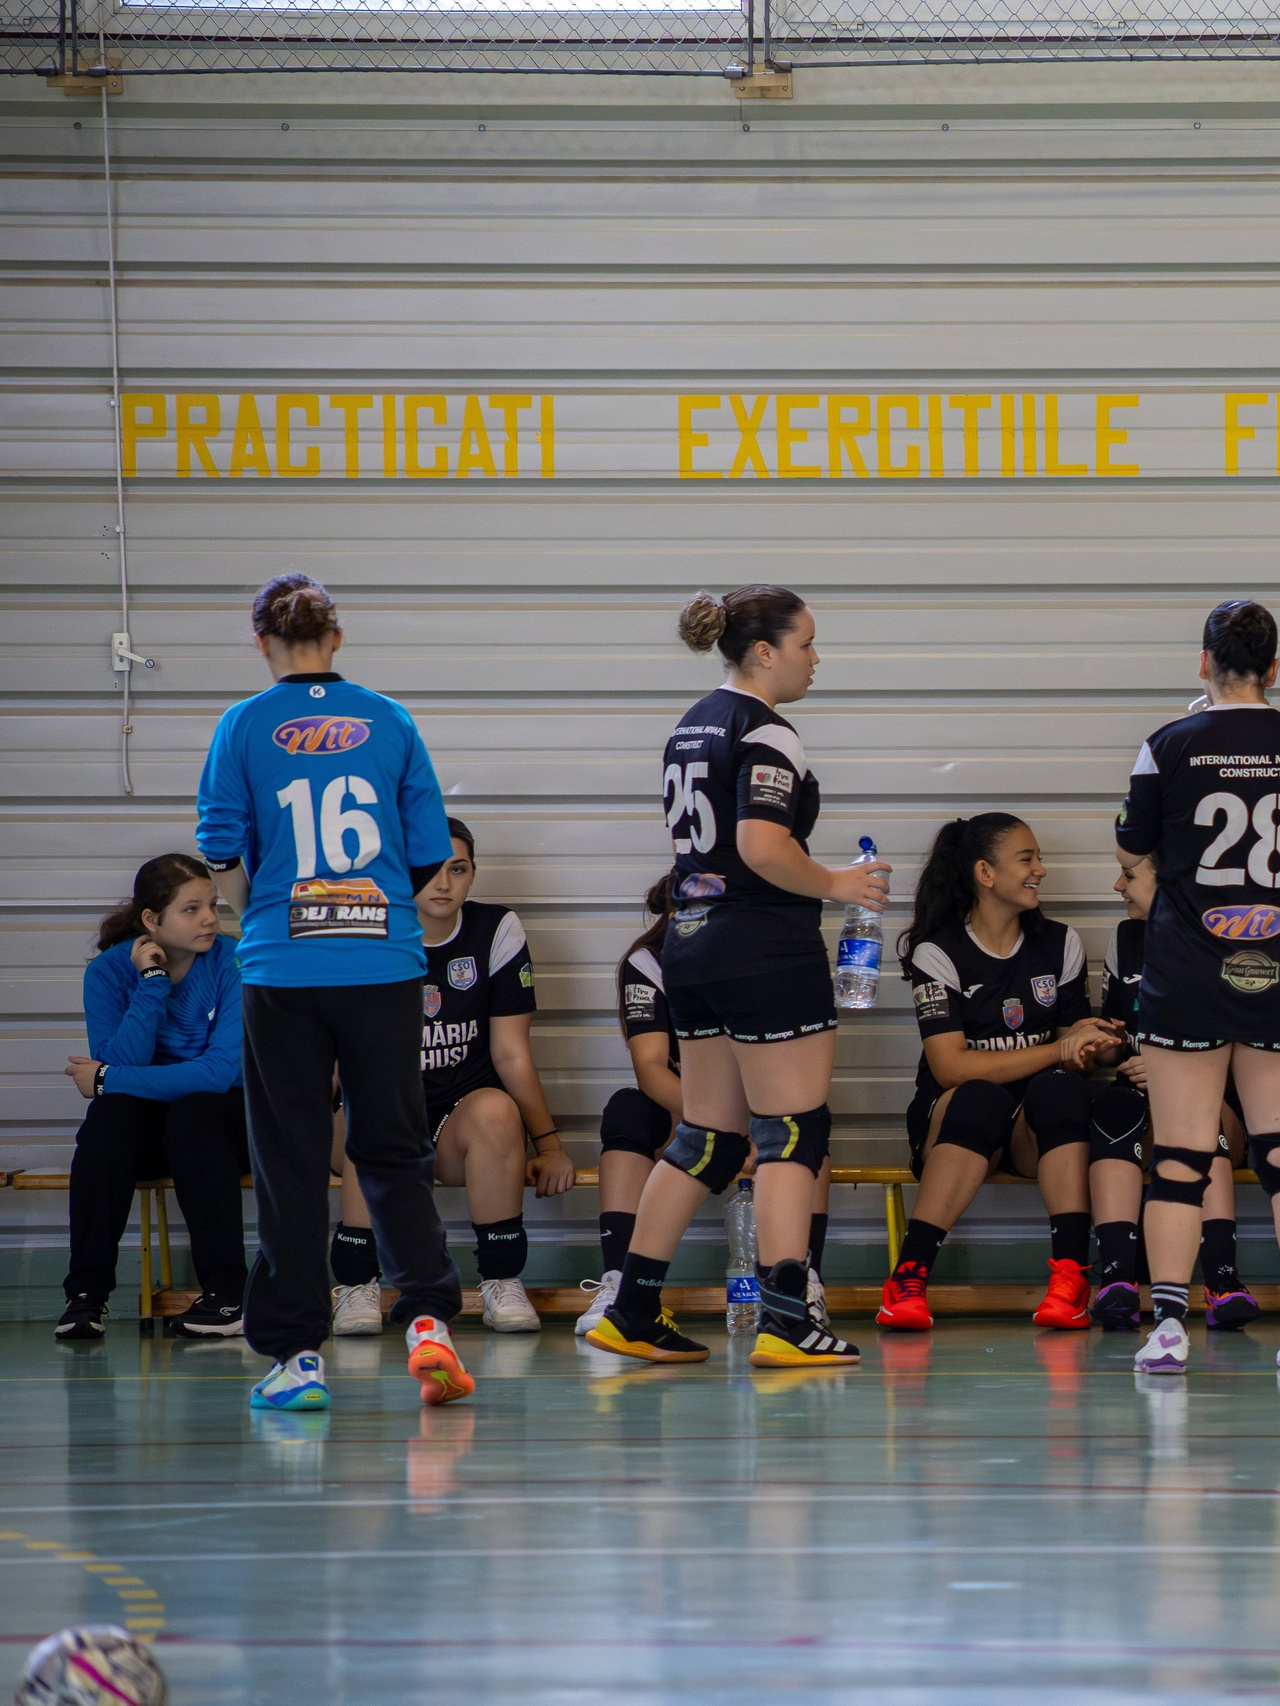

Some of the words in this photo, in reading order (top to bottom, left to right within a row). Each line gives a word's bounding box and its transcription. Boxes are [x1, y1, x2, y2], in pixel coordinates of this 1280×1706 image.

[121, 393, 555, 478] PRACTICATI
[677, 393, 1140, 479] EXERCITIILE
[278, 717, 374, 754] Wit
[1190, 754, 1272, 767] INTERNATIONAL
[663, 760, 717, 855] 25
[276, 775, 382, 878] 16
[451, 961, 470, 972] CSO
[1036, 979, 1054, 988] CSO
[421, 1020, 479, 1048] MĂRIA
[800, 1022, 824, 1033] Kempa
[764, 1029, 794, 1041] Kempa
[1149, 1033, 1175, 1046] Kempa
[1182, 1039, 1210, 1050] Kempa
[337, 1232, 367, 1246] Kempa
[487, 1232, 520, 1242] Kempa
